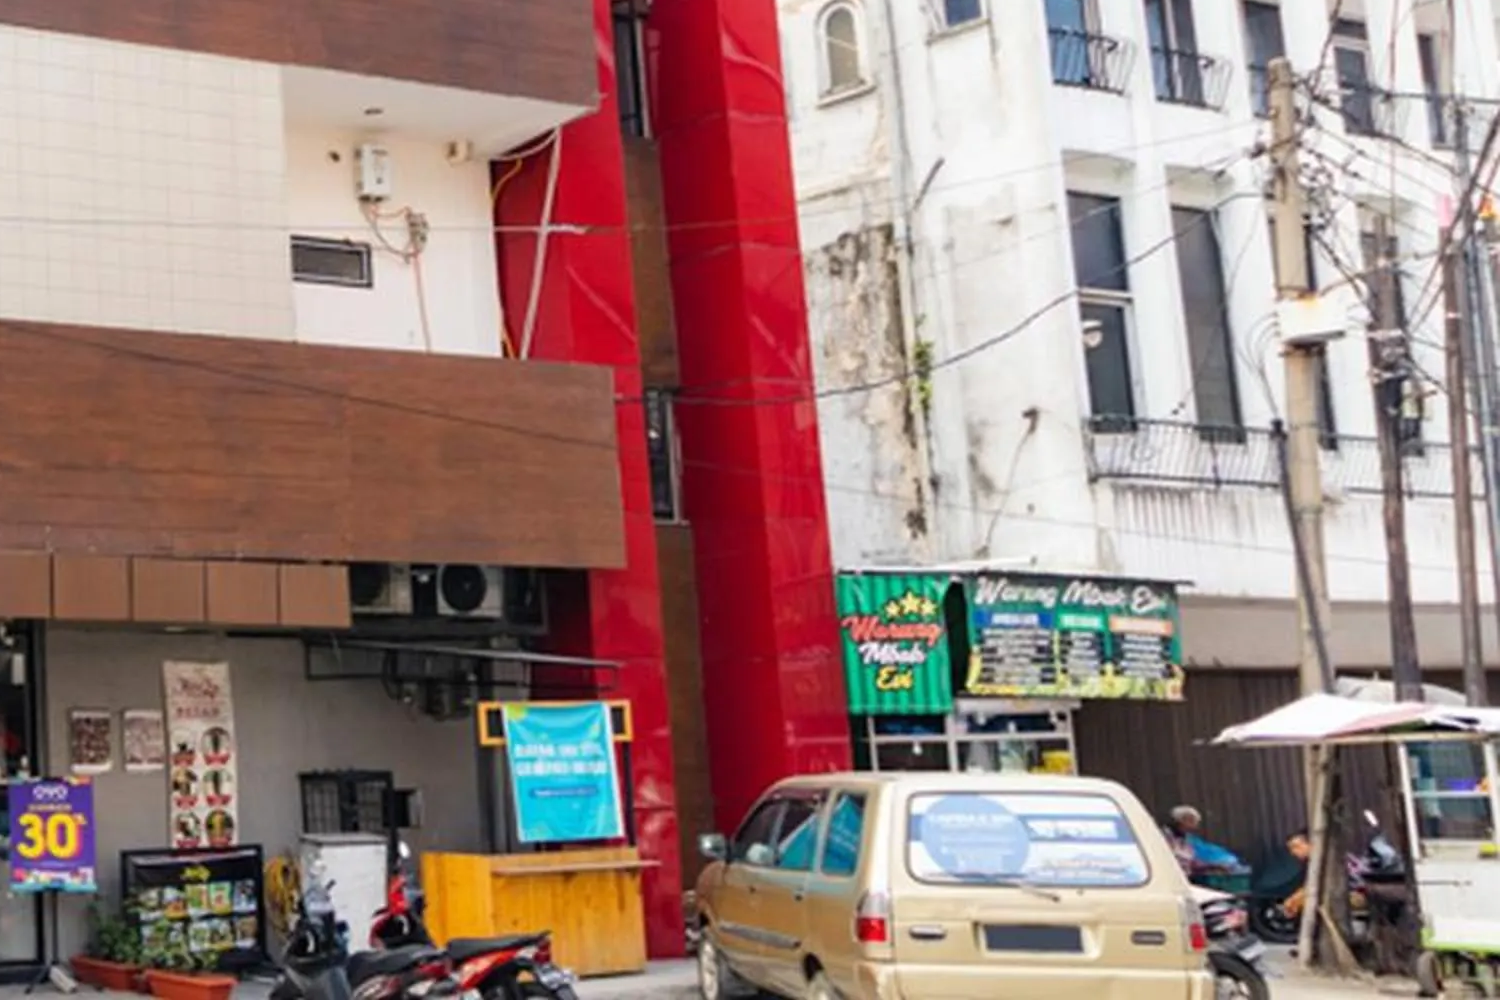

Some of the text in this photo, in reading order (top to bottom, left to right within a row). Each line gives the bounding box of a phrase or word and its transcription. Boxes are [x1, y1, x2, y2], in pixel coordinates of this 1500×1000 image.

[974, 577, 1058, 609] Warung
[841, 615, 942, 648] Warung
[858, 642, 926, 665] Mbak
